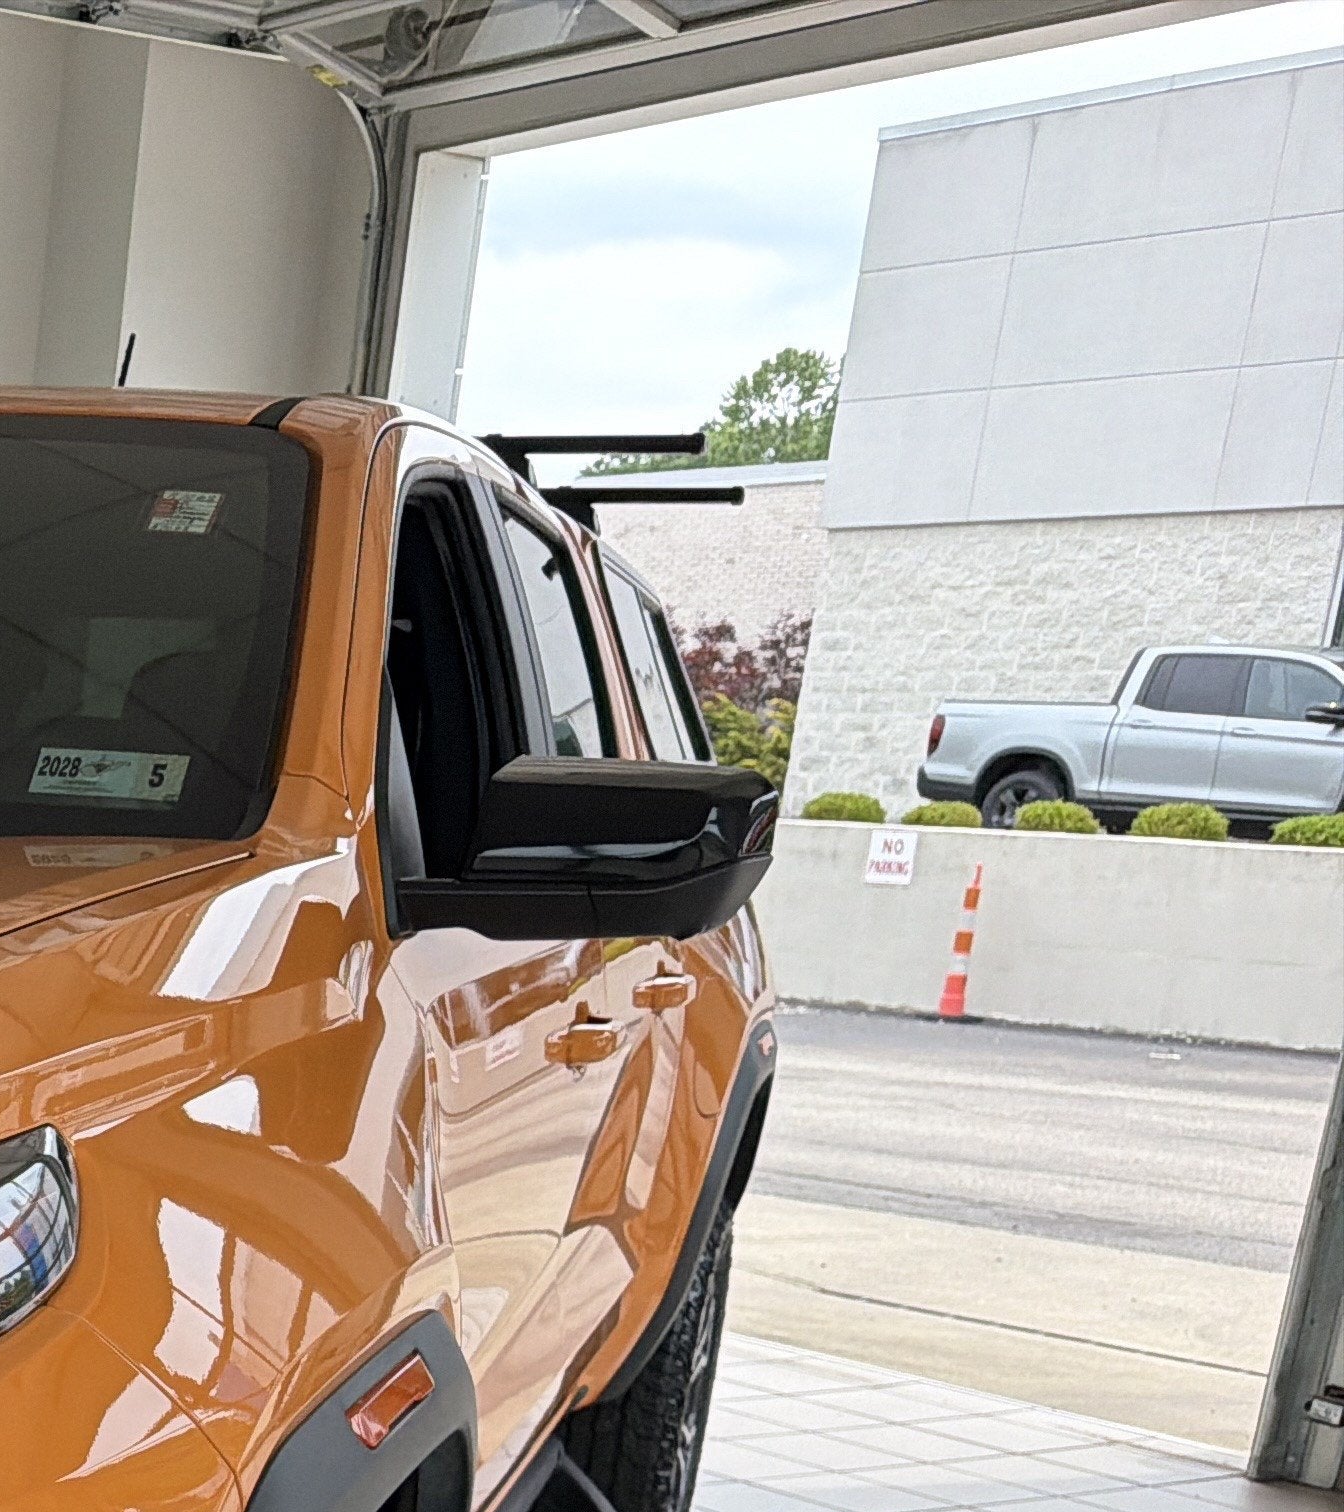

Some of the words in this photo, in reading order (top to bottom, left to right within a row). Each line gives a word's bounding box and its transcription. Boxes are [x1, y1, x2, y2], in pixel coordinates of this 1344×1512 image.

[37, 755, 82, 777] 2028
[148, 763, 168, 788] 5
[882, 838, 905, 856] NO
[868, 859, 910, 876] PARKING
